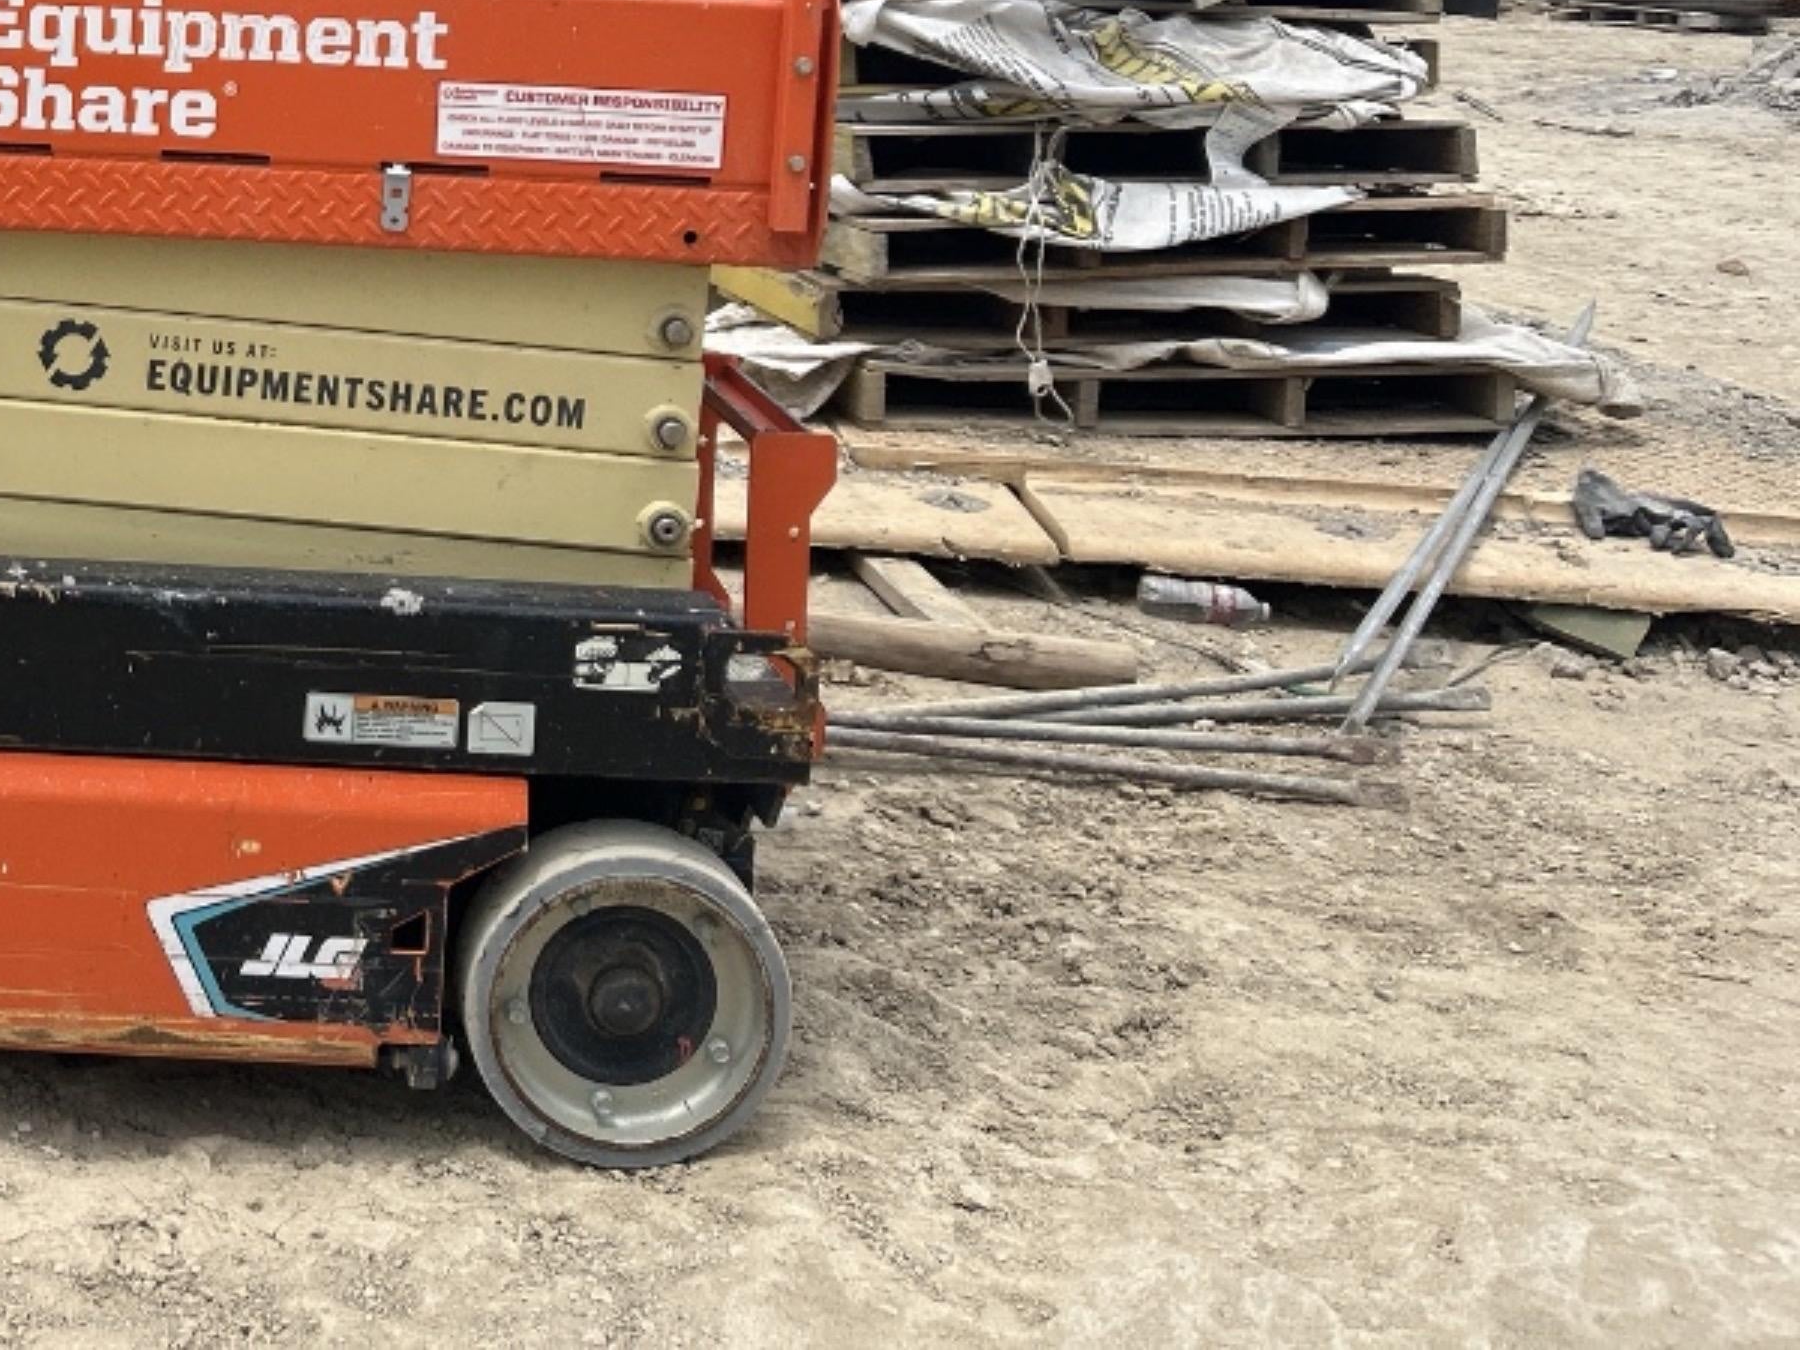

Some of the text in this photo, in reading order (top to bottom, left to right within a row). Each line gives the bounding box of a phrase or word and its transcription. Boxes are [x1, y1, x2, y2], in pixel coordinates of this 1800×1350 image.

[503, 89, 589, 108] CUSTOMER
[592, 93, 723, 114] RESPONSIBILITY
[149, 332, 277, 359] VISIT US AT:
[146, 358, 587, 430] EQUIPMENTSHARE.COM
[239, 932, 369, 979] JLG
